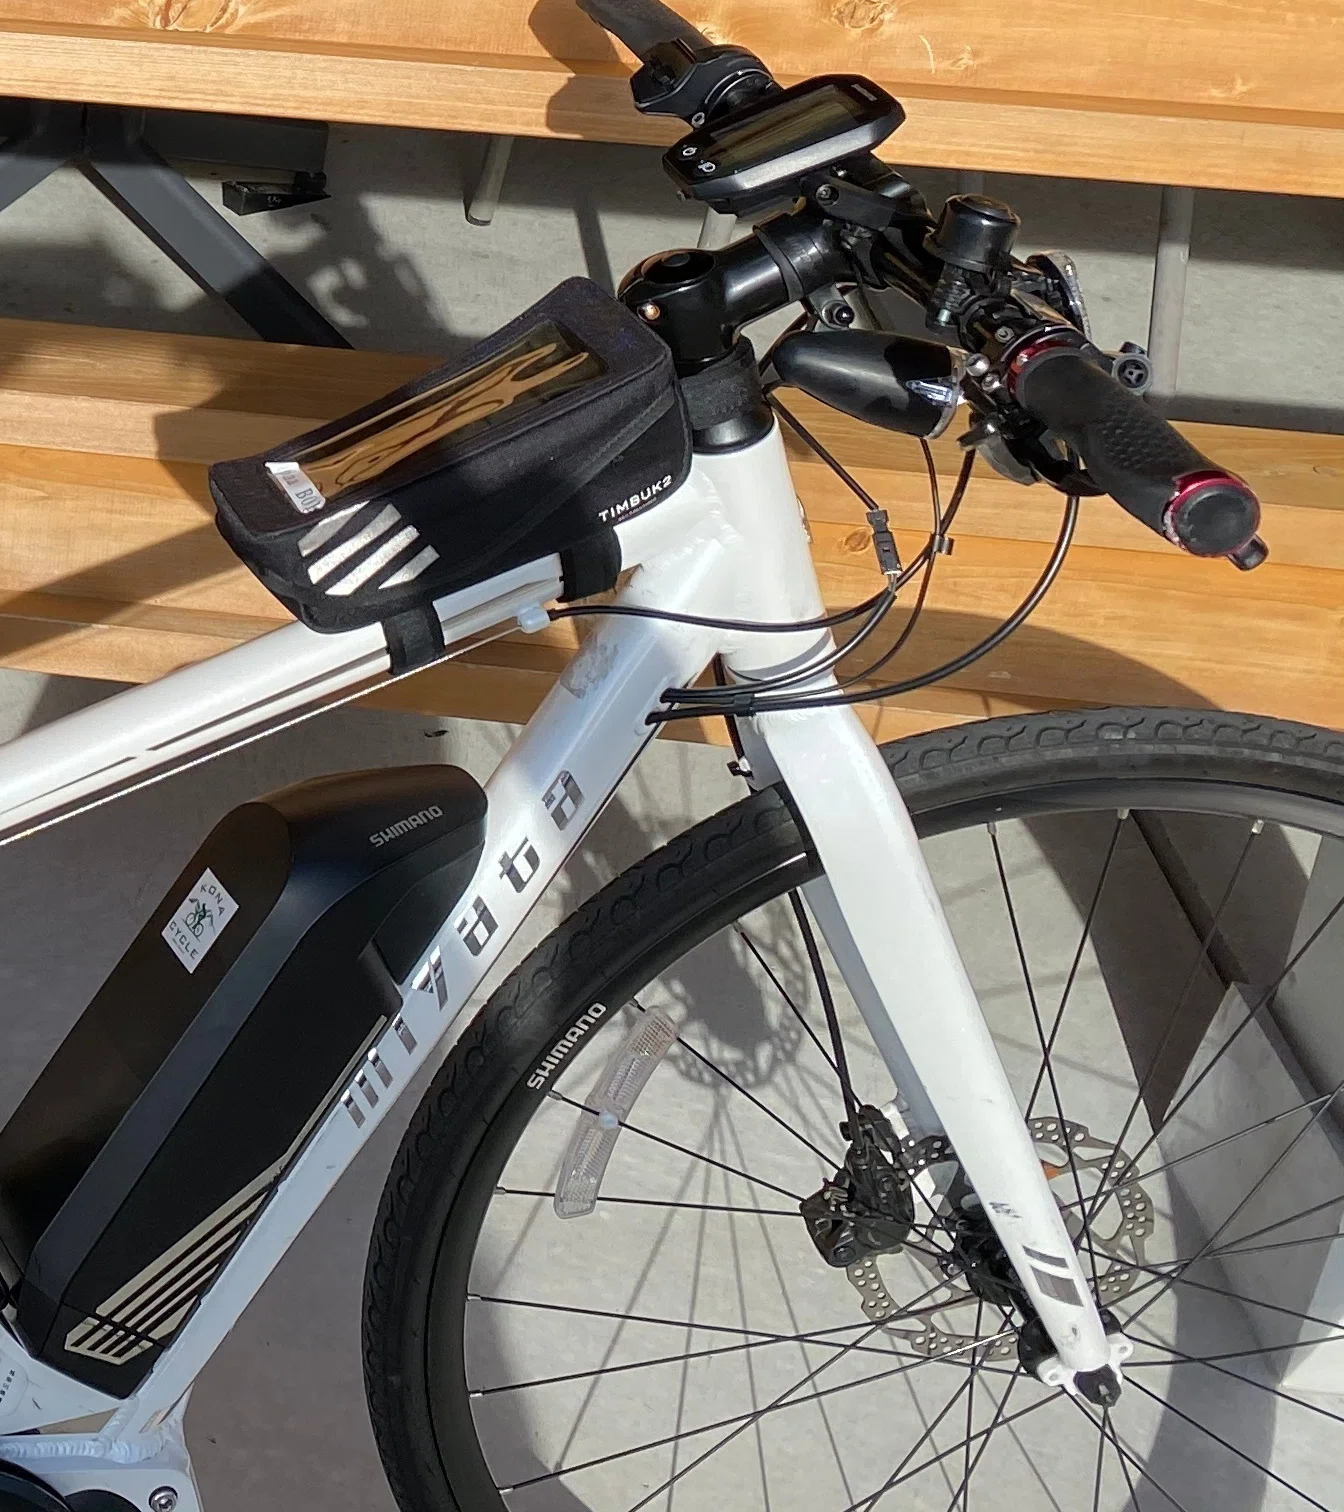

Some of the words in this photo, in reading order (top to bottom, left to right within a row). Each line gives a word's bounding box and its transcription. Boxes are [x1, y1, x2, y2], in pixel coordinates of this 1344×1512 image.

[598, 474, 673, 522] TIMBUK2
[369, 805, 443, 848] SHIMANO
[199, 884, 226, 917] KONA
[169, 920, 199, 960] CYCLE
[526, 1002, 607, 1090] SHIMANO
